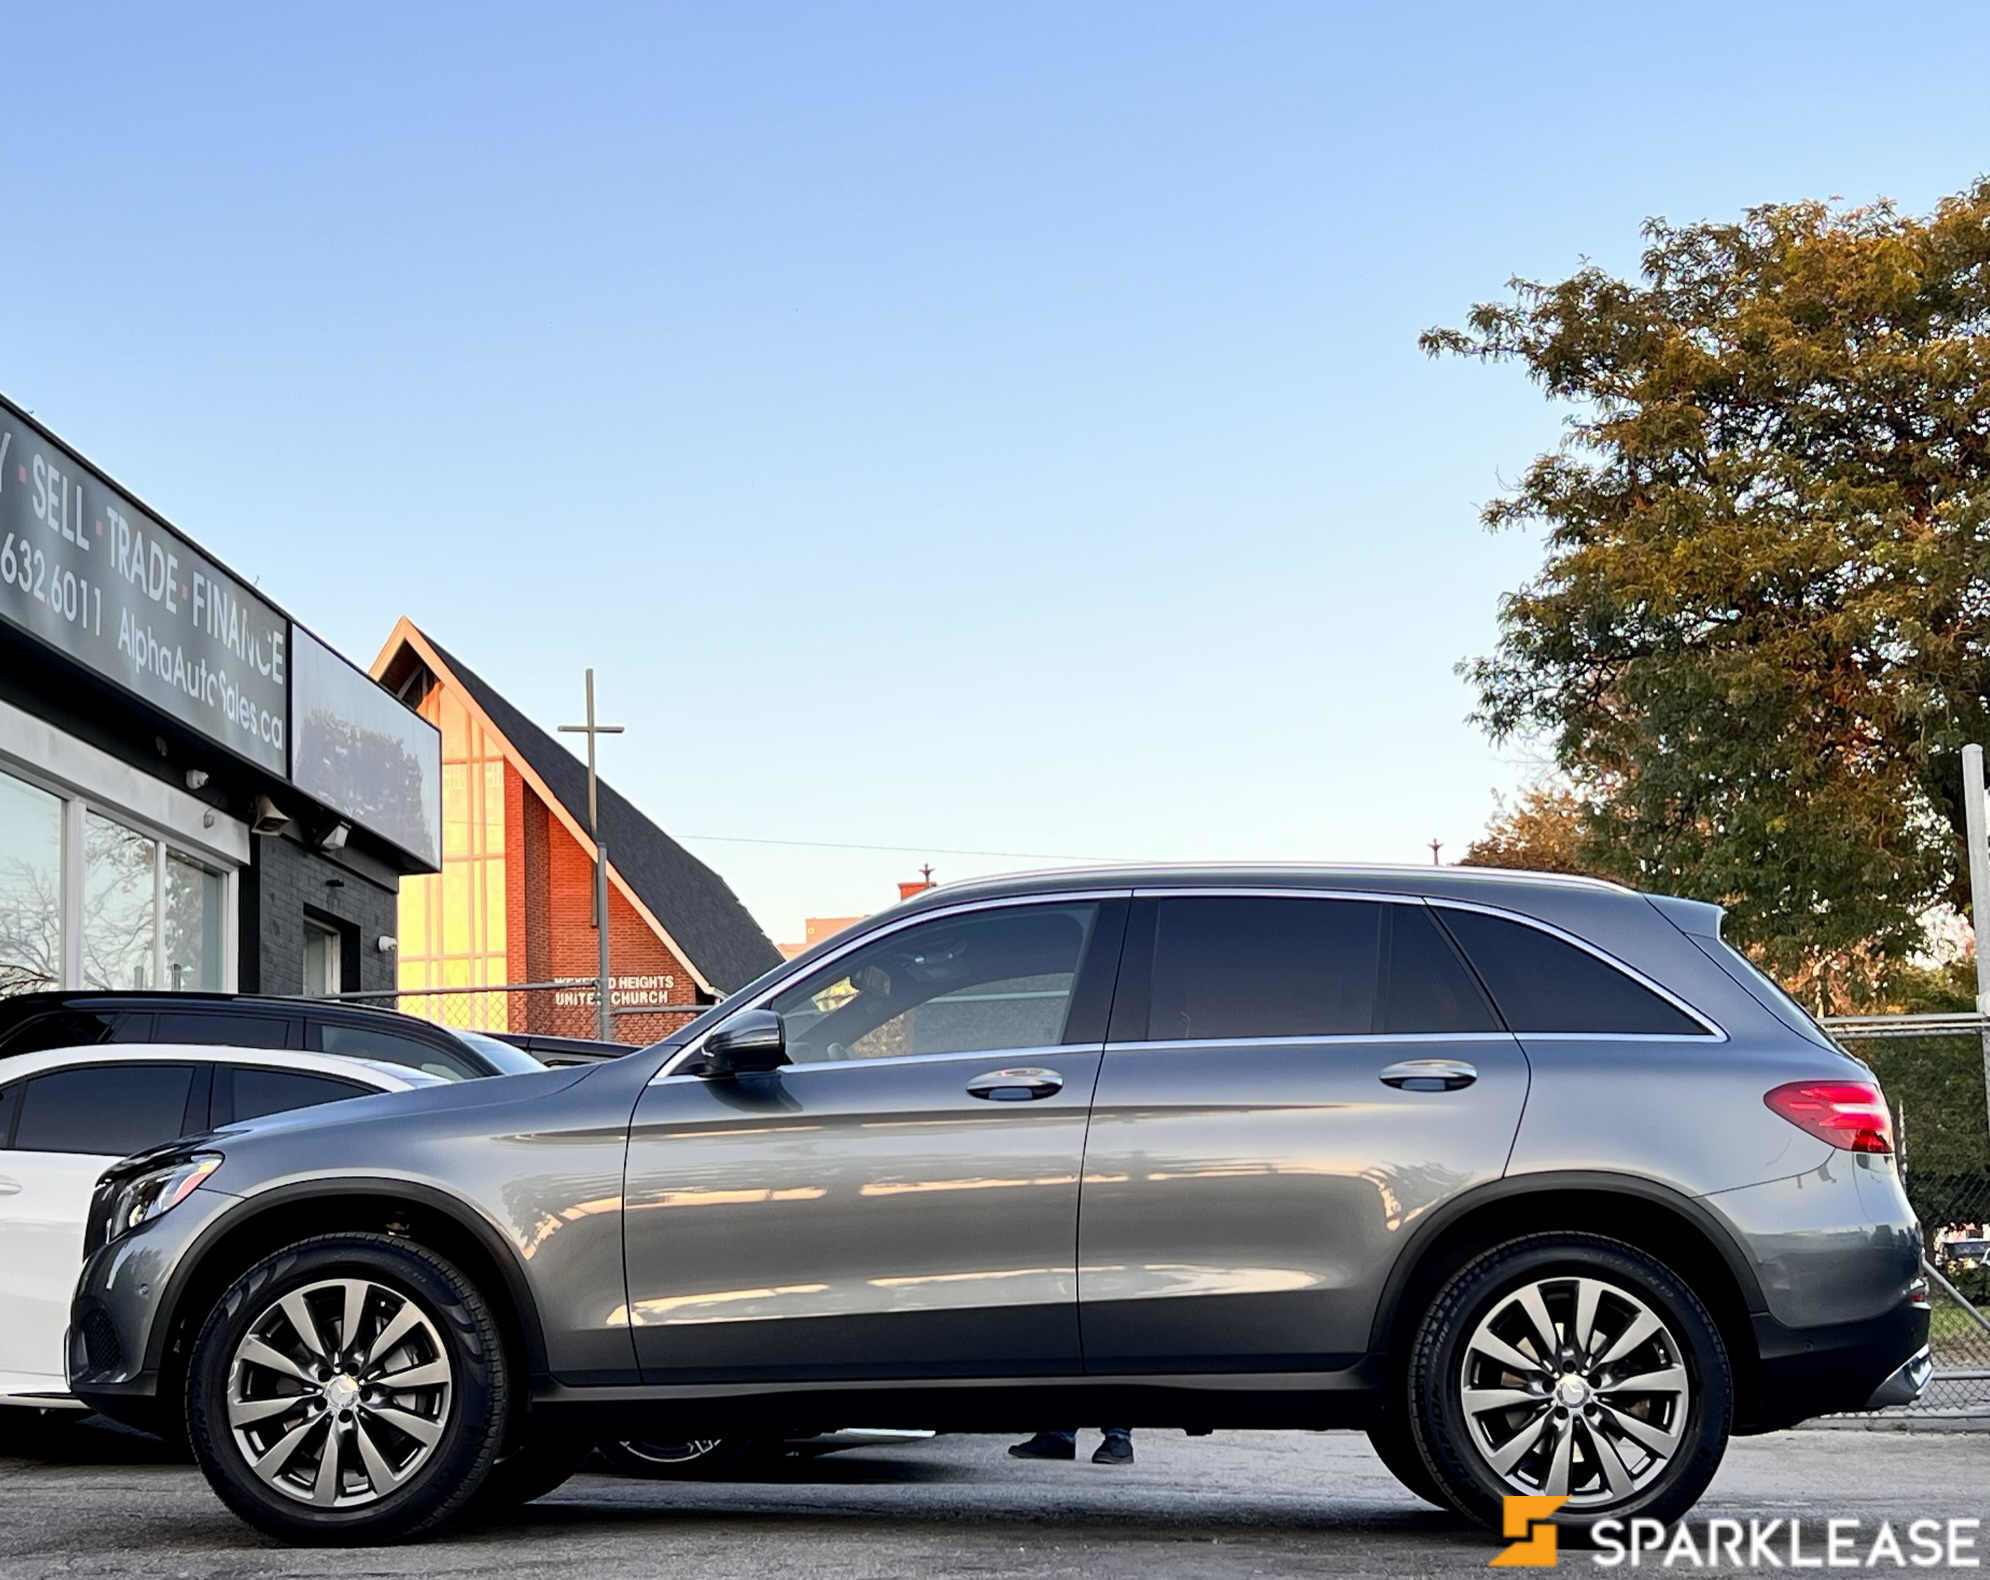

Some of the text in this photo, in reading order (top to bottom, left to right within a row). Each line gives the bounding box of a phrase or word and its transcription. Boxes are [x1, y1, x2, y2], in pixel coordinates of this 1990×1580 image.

[32, 453, 90, 551] SELL
[106, 506, 178, 615] TRADE
[619, 975, 674, 989] HEIGHTS
[555, 991, 668, 1005] UNITE CHURCH
